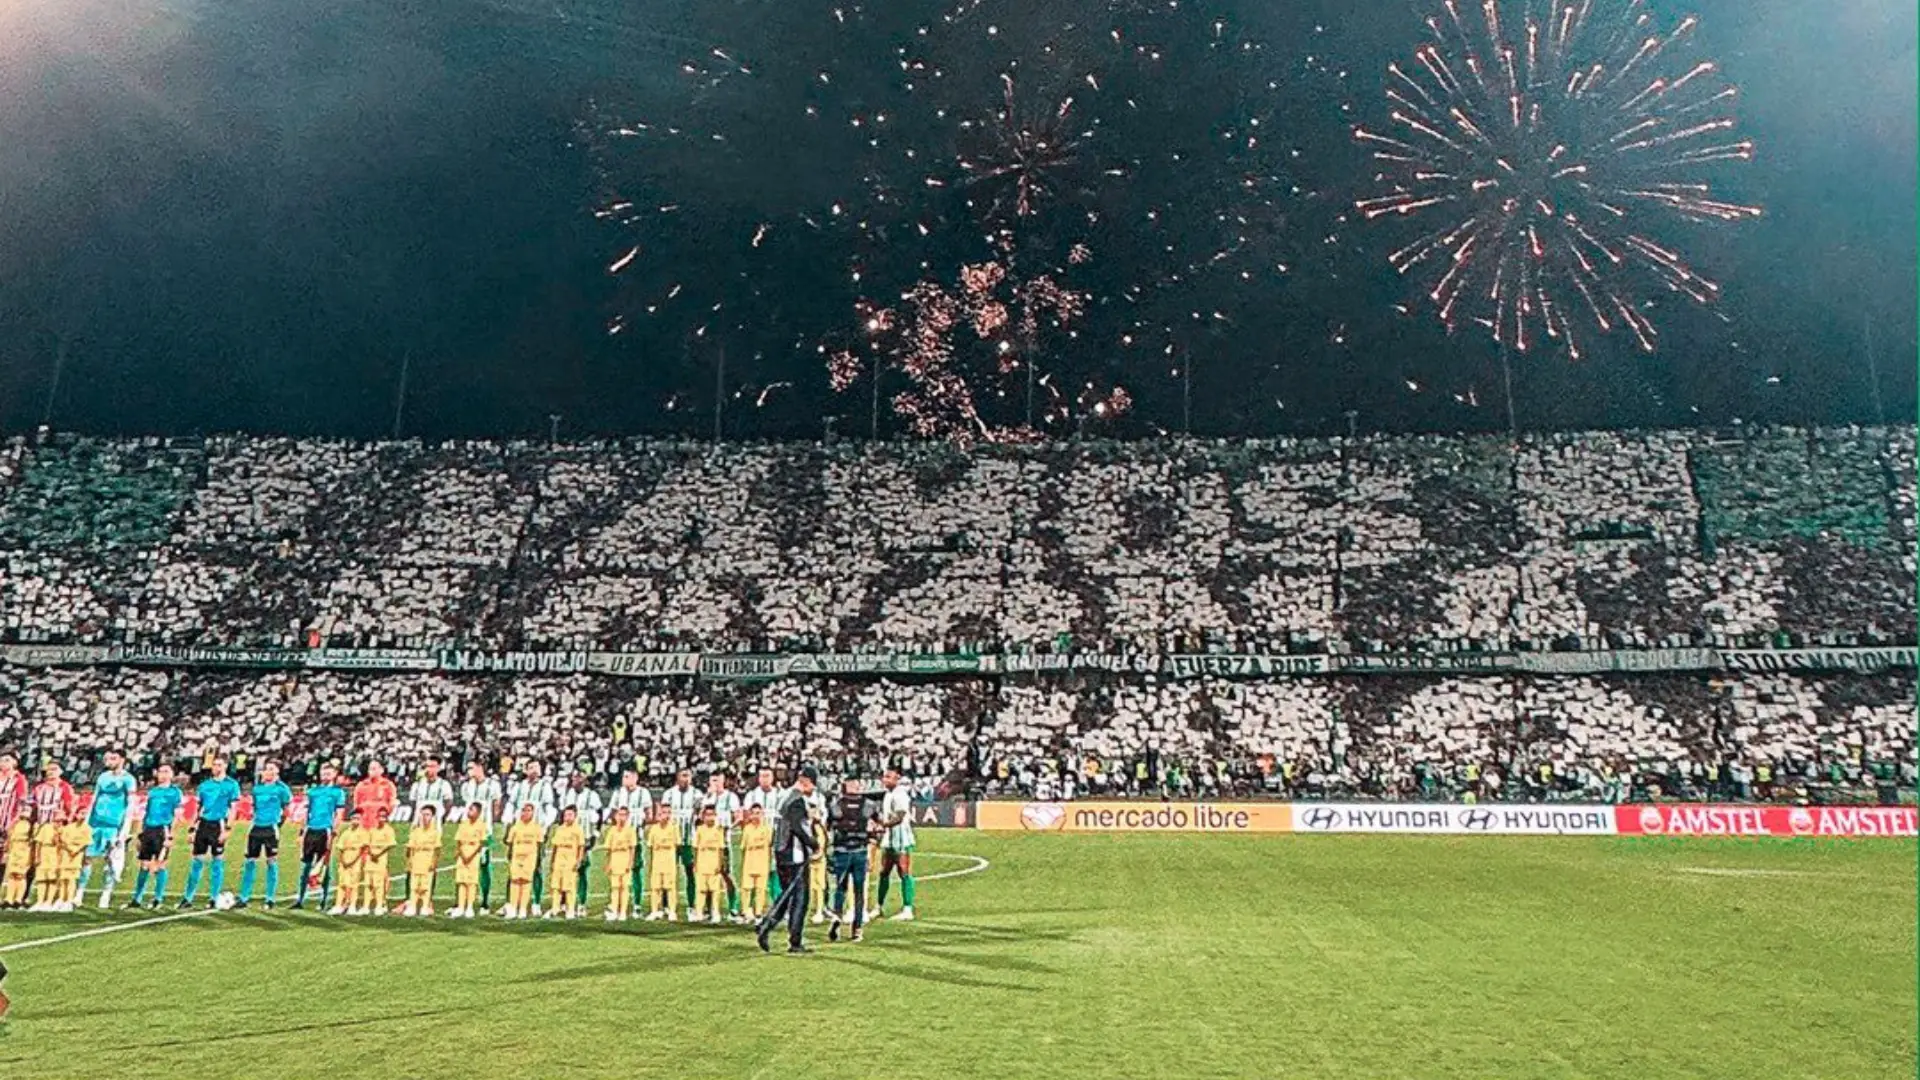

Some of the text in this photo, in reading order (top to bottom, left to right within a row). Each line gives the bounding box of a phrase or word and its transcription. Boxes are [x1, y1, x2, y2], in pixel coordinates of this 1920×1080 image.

[1174, 657, 1262, 675] FUERZA
[1075, 806, 1249, 828] mercado libre
[1348, 810, 1450, 827] HYUNDAI
[1504, 811, 1608, 829] HYUNDAI
[1668, 807, 1771, 834] AMSTEL
[1819, 807, 1918, 835] AMSTEL
